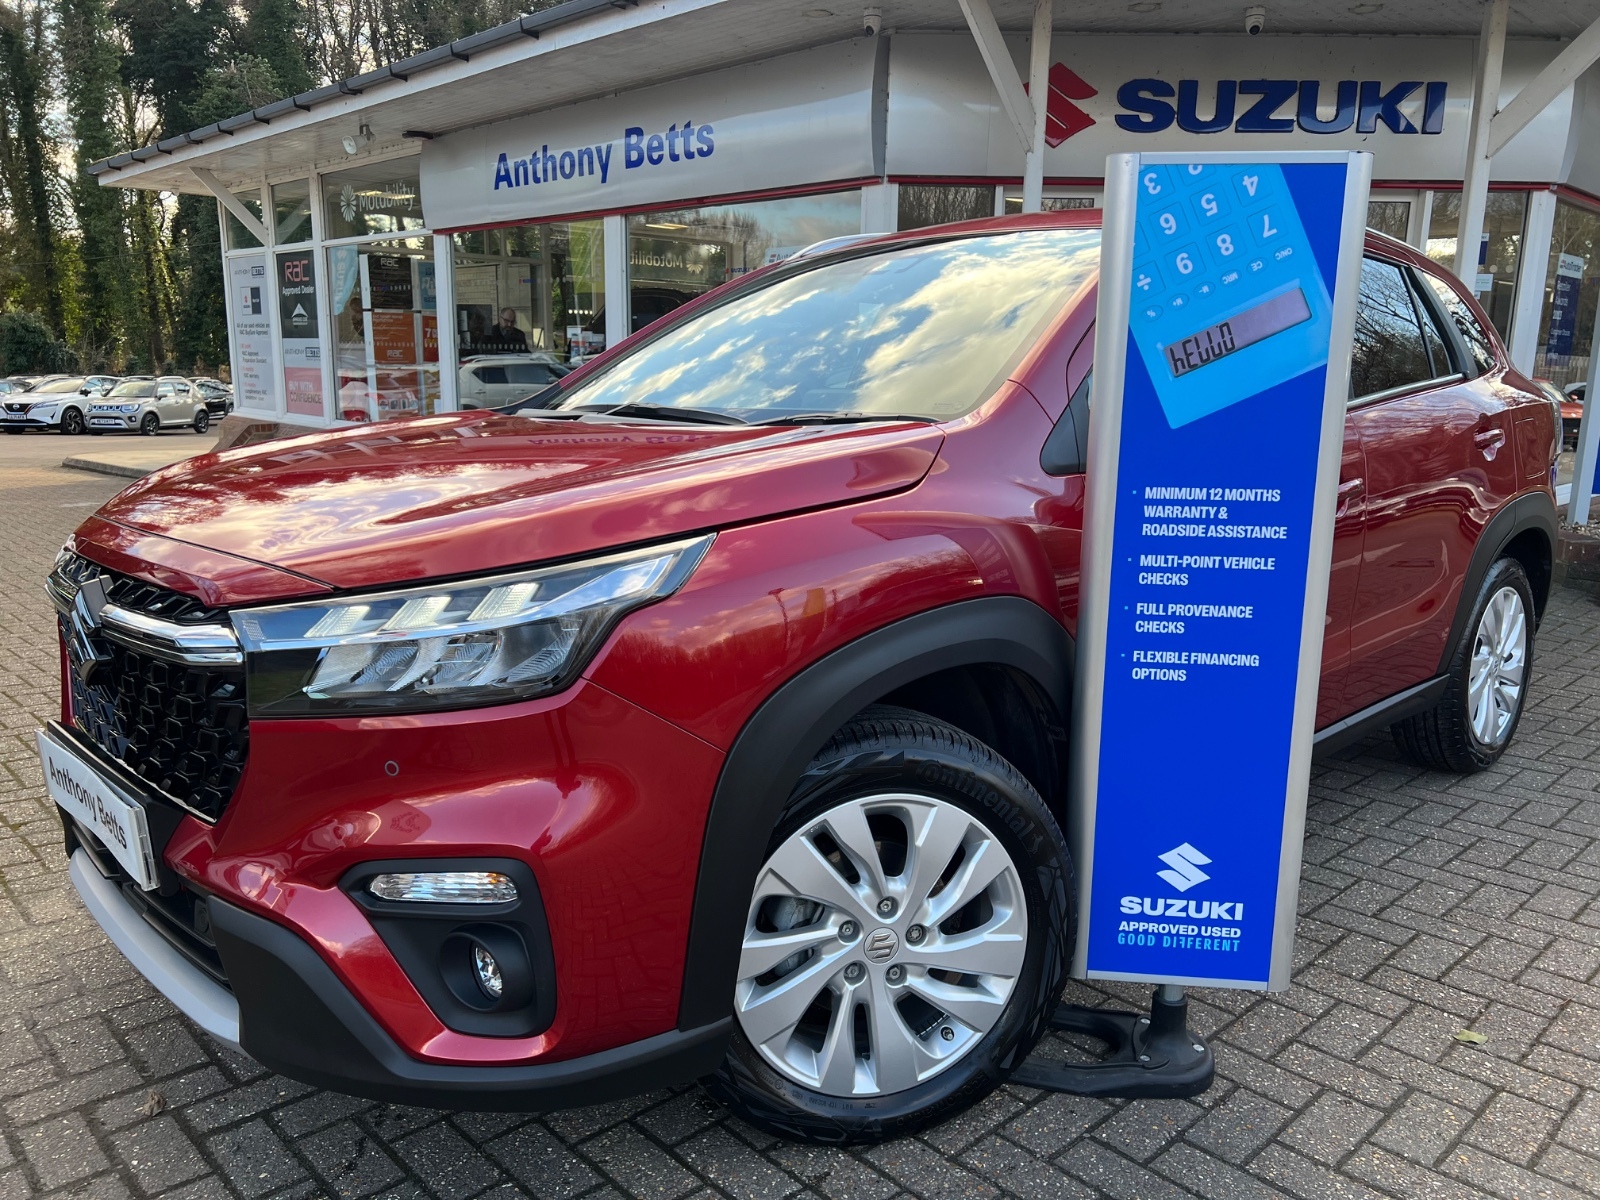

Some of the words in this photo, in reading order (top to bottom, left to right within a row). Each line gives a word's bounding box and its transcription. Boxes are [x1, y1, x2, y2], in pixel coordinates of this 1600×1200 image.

[1115, 79, 1448, 135] SUZUKI
[494, 144, 612, 190] Anthony
[624, 120, 715, 170] Betts
[1144, 172, 1161, 195] 3
[1242, 174, 1259, 197] 4
[360, 181, 415, 212] Motability
[1201, 193, 1218, 217] 5
[1262, 214, 1278, 239] 7
[1216, 233, 1234, 256] 8
[284, 260, 310, 283] RAC
[282, 286, 301, 297] Approved
[1144, 486, 1207, 501] MINIMUM
[1208, 487, 1223, 501] 12
[1224, 488, 1281, 502] MONTHS
[1143, 505, 1217, 519] WARRANTY
[1218, 506, 1228, 520] &
[1141, 523, 1206, 538] ROADSIDE
[1207, 525, 1288, 540] ASSISTANCE
[1139, 554, 1222, 569] MULTI-POINT
[1223, 556, 1276, 571] VEHICLE
[1138, 572, 1189, 586] CHECKS
[1136, 602, 1166, 616] FULL
[1167, 603, 1254, 619] PROVENANCE
[1135, 620, 1185, 634] CHECKS
[1132, 650, 1189, 665] FLEXIBLE
[1190, 652, 1260, 667] FINANCING
[1131, 667, 1187, 682] OPTIONS
[48, 756, 97, 822] Anthony
[97, 794, 128, 850] Betts
[1119, 896, 1244, 921] SUZUKI
[1118, 920, 1199, 936] APPROVED
[1200, 925, 1242, 938] USED
[1117, 932, 1156, 947] GOOD
[1162, 935, 1241, 952] DIFFERENT
